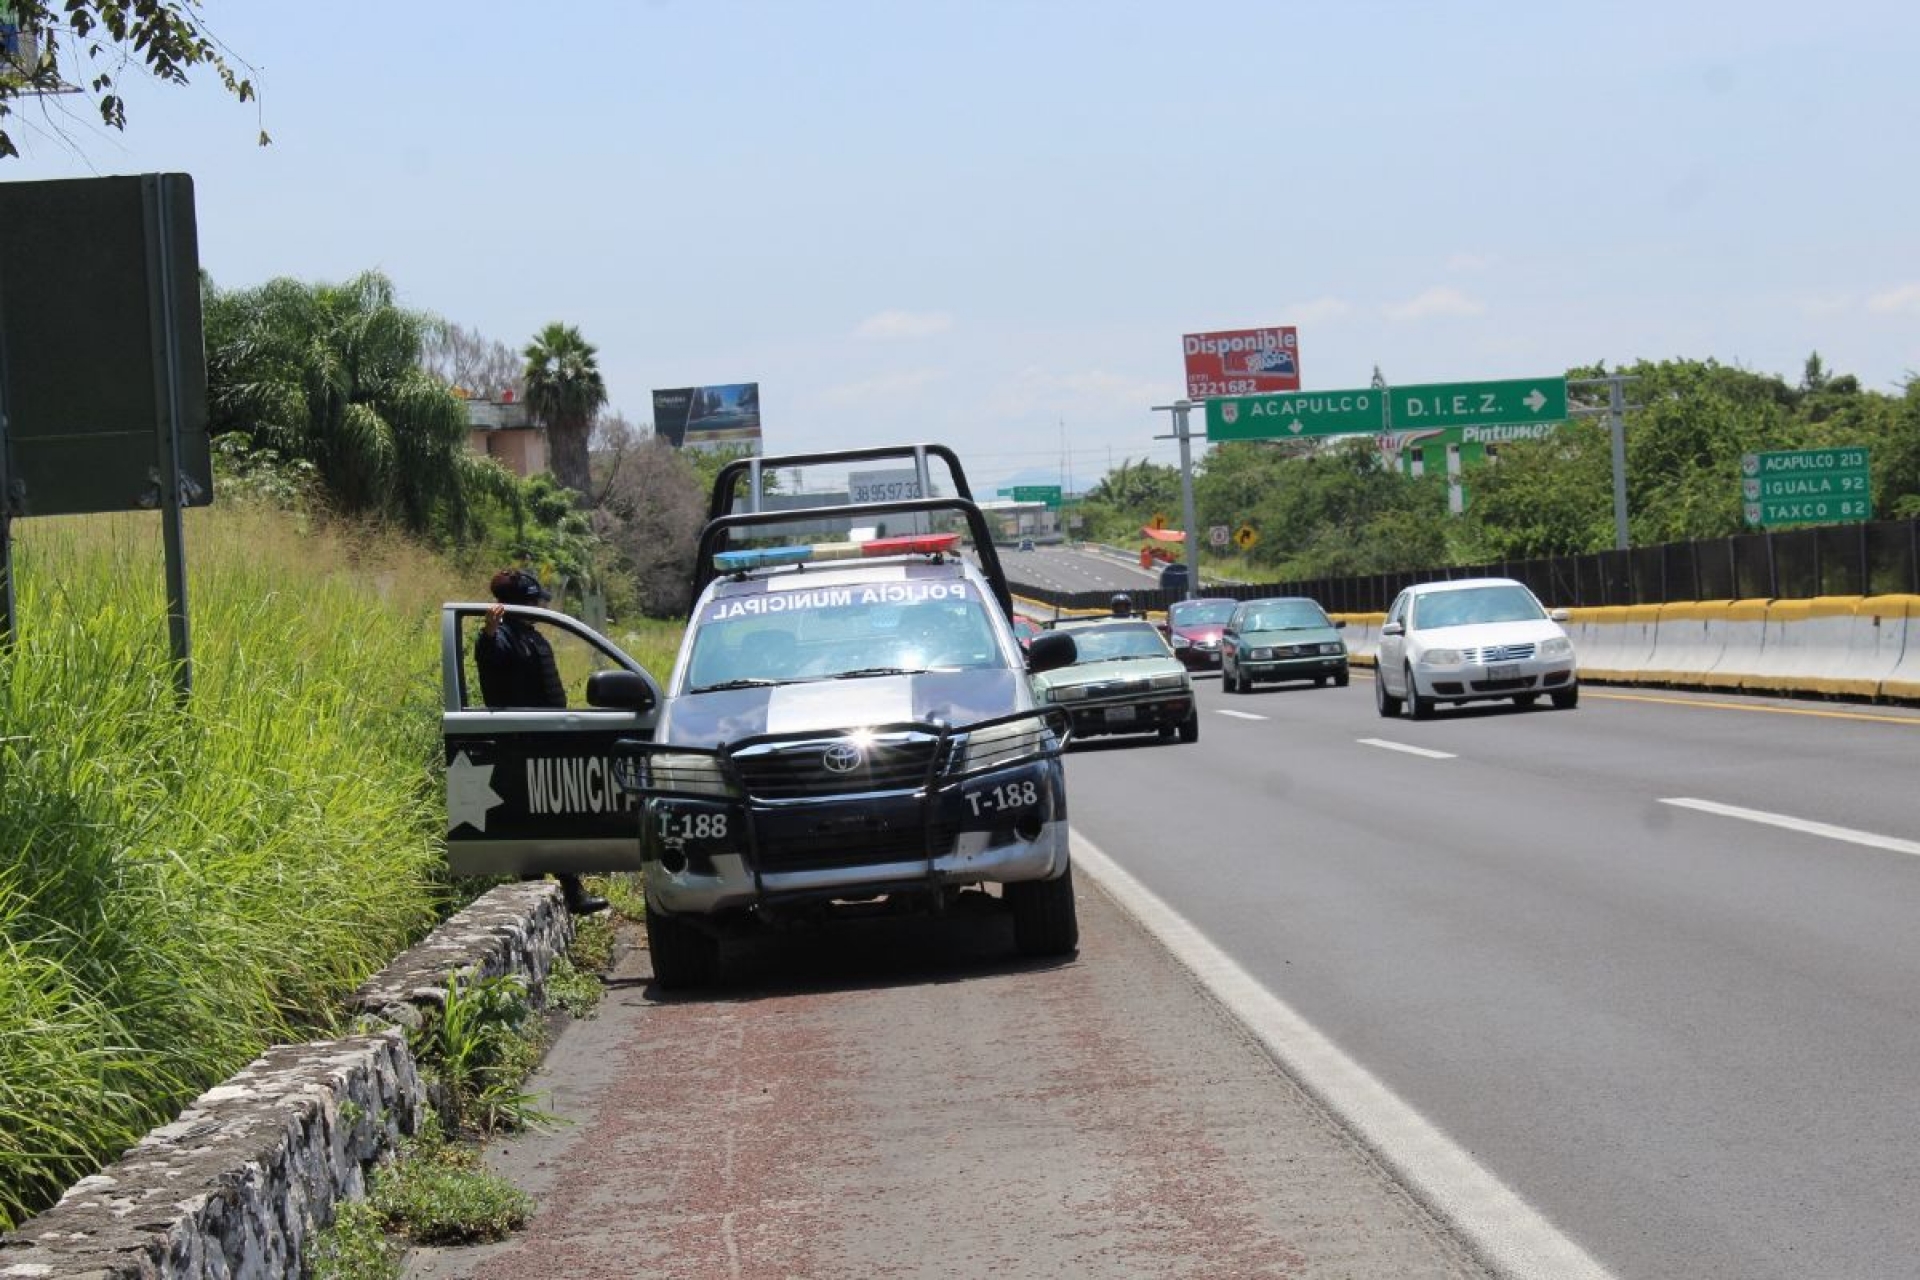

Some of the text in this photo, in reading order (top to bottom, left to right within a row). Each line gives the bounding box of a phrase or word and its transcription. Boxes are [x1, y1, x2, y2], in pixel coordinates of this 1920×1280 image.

[1184, 328, 1295, 357] Disponible
[1189, 378, 1257, 396] 3221682
[1251, 396, 1369, 417] ACAPULCO
[1407, 394, 1503, 417] D.I.E.Z.
[1766, 455, 1833, 471] ACAPULCO
[1840, 452, 1862, 467] 213
[1766, 478, 1831, 495] IGUALA
[1841, 477, 1864, 490] 92
[1768, 503, 1827, 519] TAXCO
[965, 781, 1038, 817] T-188
